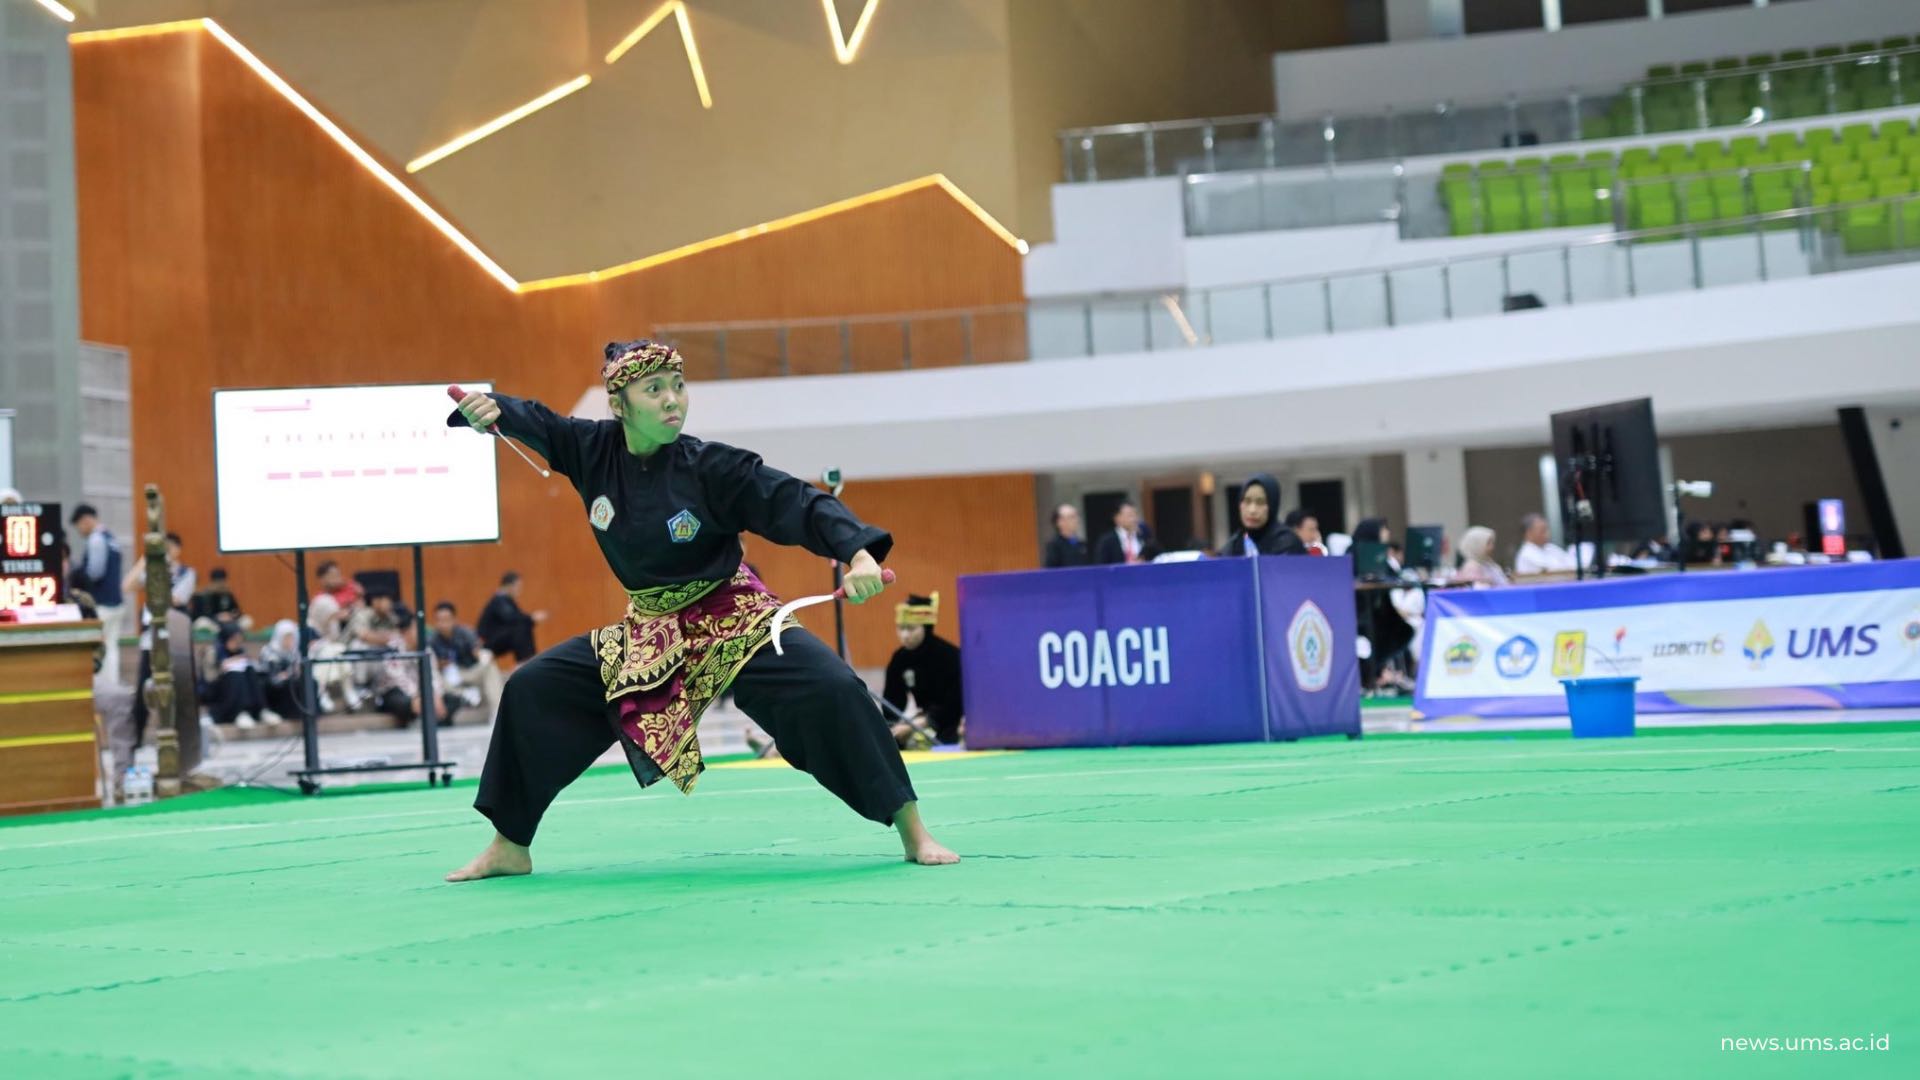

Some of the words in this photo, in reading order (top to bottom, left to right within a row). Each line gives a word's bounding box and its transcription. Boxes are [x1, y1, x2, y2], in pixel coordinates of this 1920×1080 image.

[3, 559, 43, 573] TIMER
[1038, 626, 1171, 689] COACH
[1787, 624, 1881, 659] UMS
